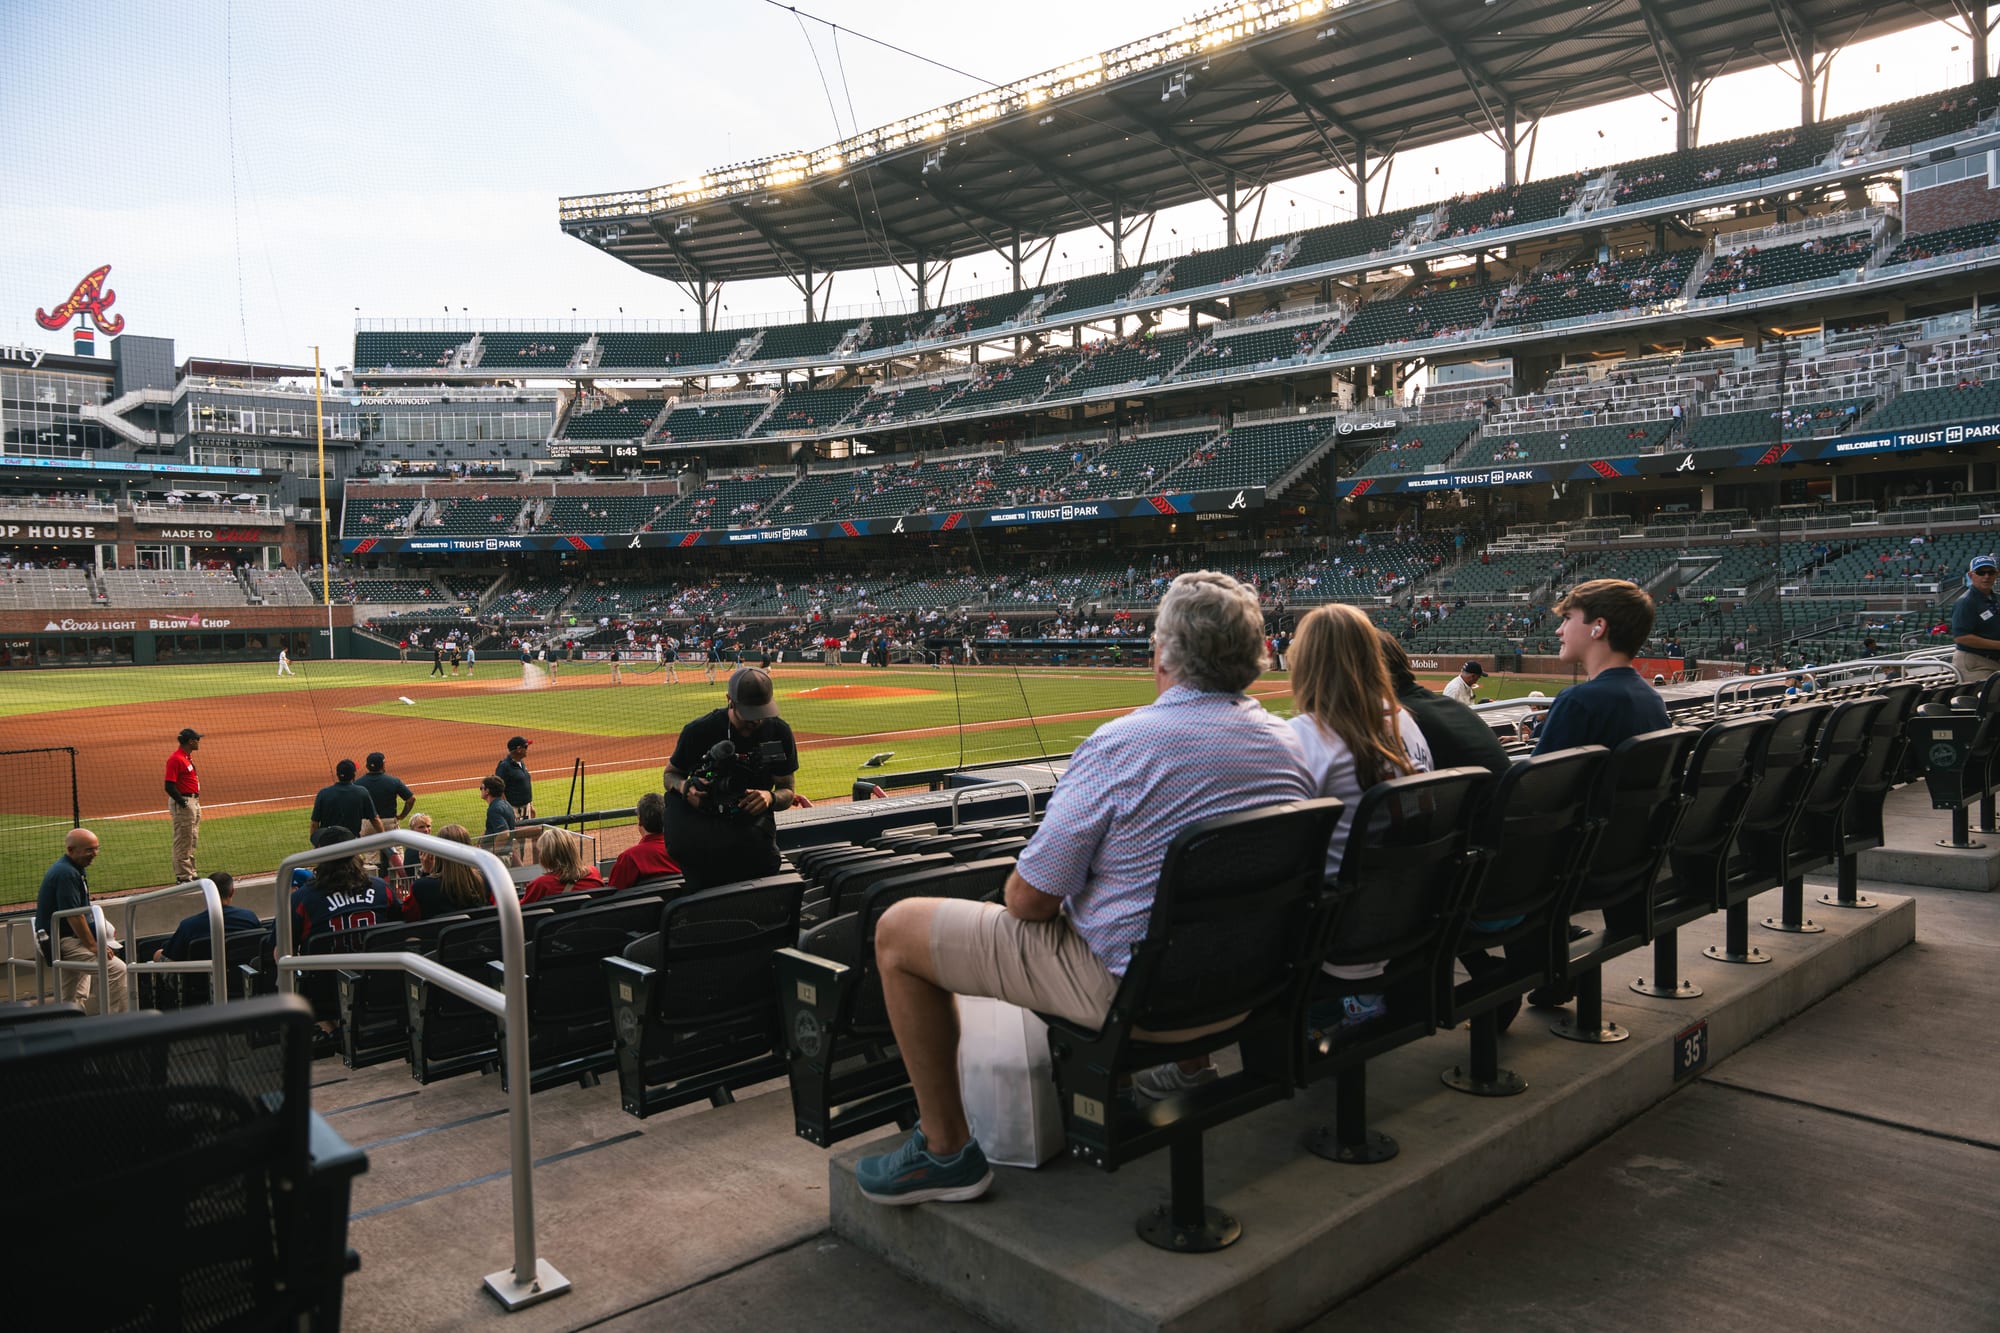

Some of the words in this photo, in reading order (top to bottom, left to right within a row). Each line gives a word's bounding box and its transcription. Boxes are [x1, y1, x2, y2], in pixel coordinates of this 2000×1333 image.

[362, 398, 393, 406] KONICA
[394, 398, 430, 406] MINOLTA
[1354, 420, 1396, 431] LEXUS
[1836, 441, 1878, 451] WELCOME
[1879, 439, 1891, 447] TO
[1899, 431, 1944, 446] TRUIST
[1965, 425, 2000, 438] PARK
[616, 447, 638, 456] 6:45
[1454, 474, 1489, 485] TRUIST
[1505, 470, 1533, 481] PARK
[1030, 509, 1061, 520] TRUIST
[1074, 506, 1099, 517] PARK
[28, 526, 96, 539] HOUSE
[161, 530, 196, 538] MADE
[197, 530, 213, 538] TO
[215, 526, 261, 542] Chill
[760, 531, 782, 540] TRUIST
[791, 529, 808, 537] PARK
[454, 541, 485, 549] TRUIST
[498, 540, 522, 548] PARK
[61, 618, 100, 631] Coors
[102, 621, 136, 630] LIGHT
[149, 619, 188, 629] BELOW
[201, 618, 231, 628] CHOP
[1411, 659, 1438, 669] Mobile
[326, 888, 376, 912] JONES
[1684, 1029, 1702, 1067] 35
[1084, 1101, 1095, 1116] 13
